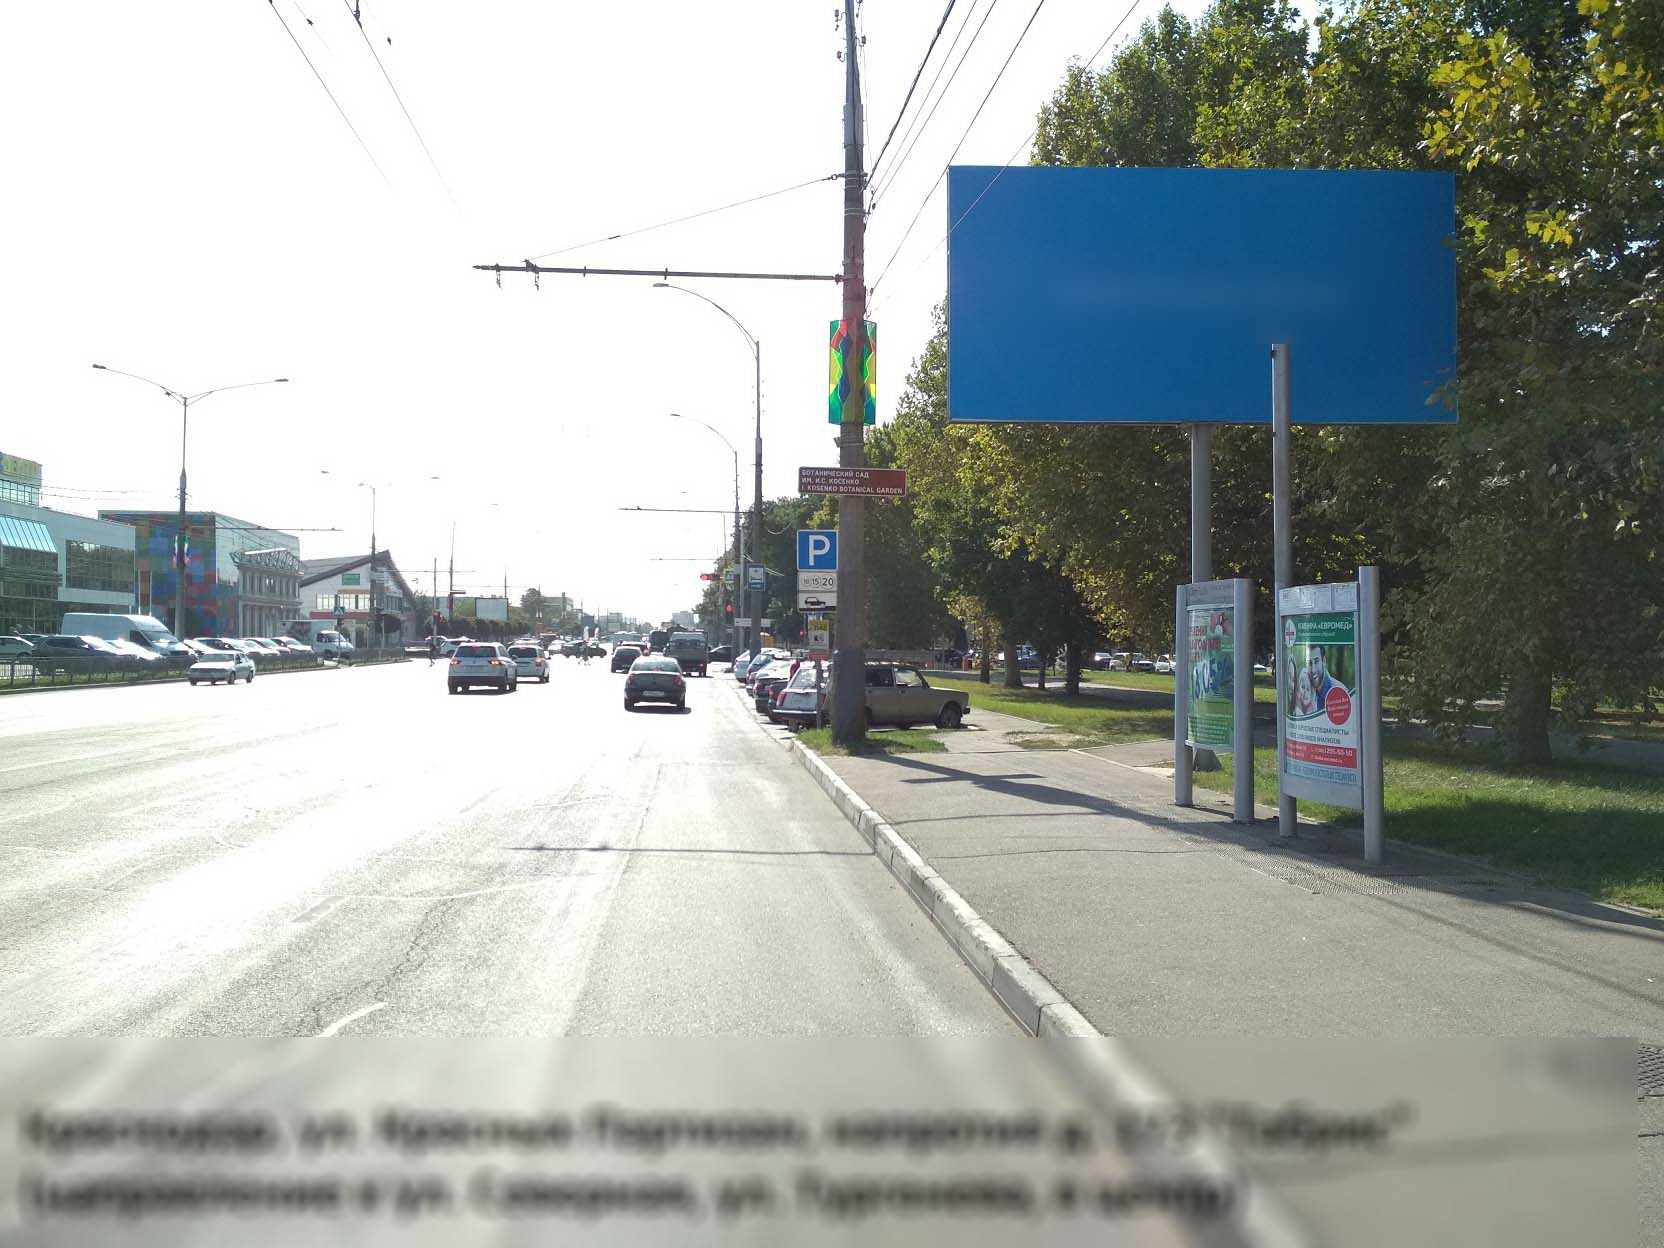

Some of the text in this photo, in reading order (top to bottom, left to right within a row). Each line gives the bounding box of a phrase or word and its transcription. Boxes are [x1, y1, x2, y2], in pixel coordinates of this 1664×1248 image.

[801, 469, 853, 478] БОТАНИЧЕСКИЙ
[808, 534, 831, 566] P
[812, 578, 820, 586] 15
[822, 577, 834, 586] 20
[1318, 621, 1353, 630] «ЕВРОМЕД»
